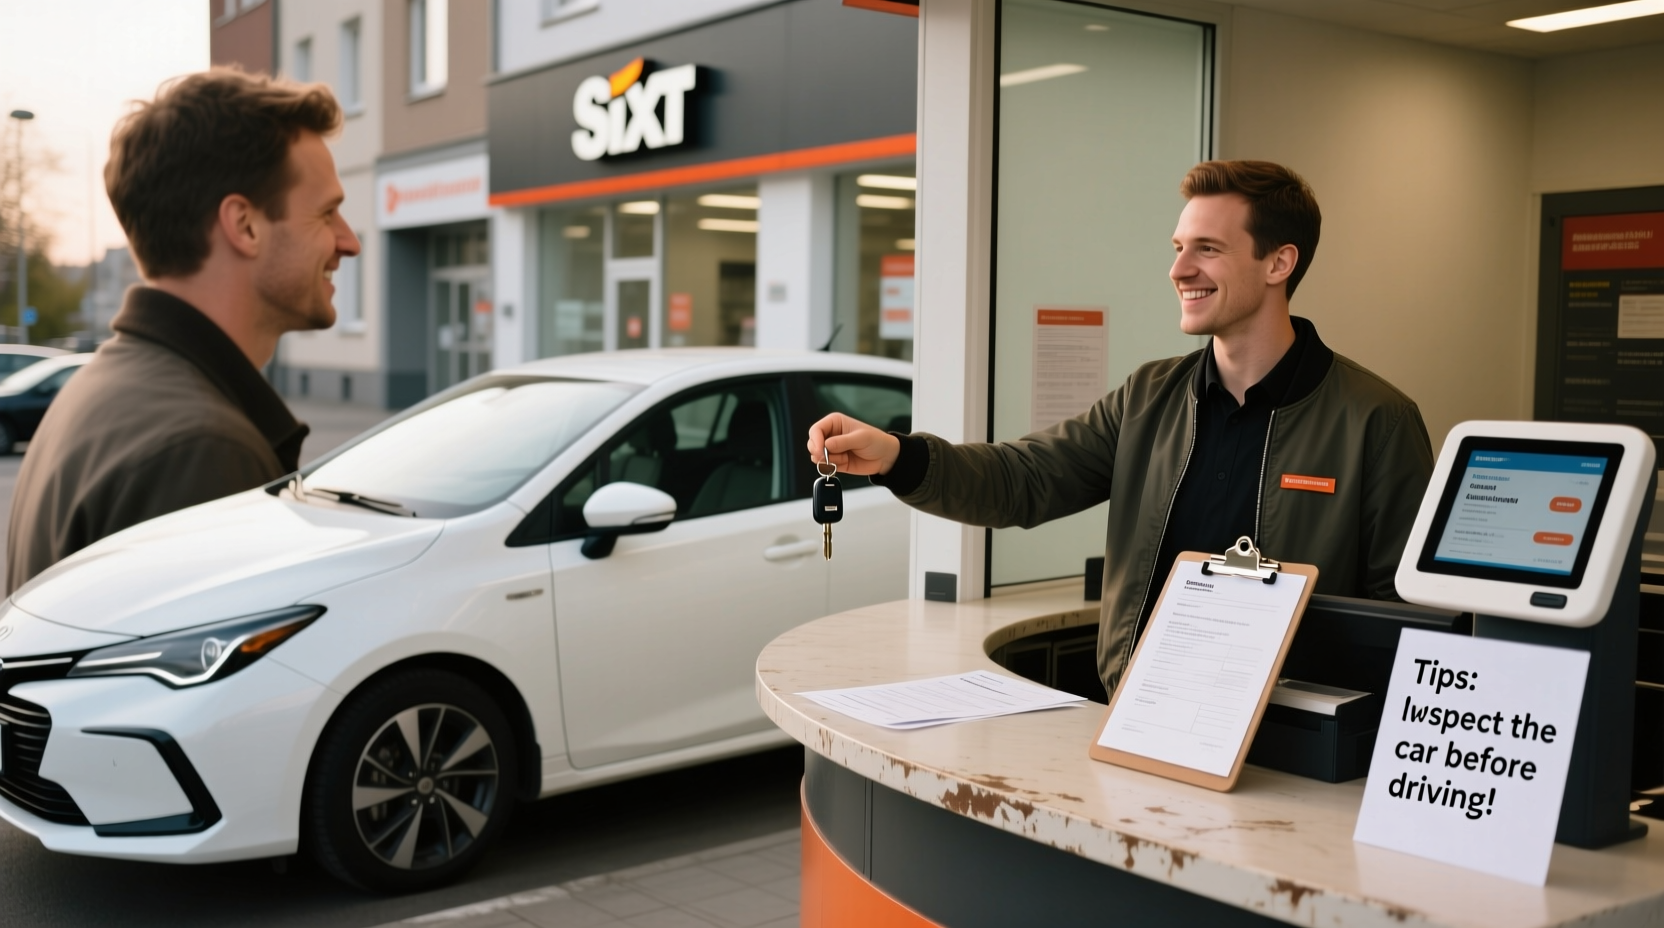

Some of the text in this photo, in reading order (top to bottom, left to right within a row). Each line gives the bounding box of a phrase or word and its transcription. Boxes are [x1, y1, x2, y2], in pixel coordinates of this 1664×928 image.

[1414, 658, 1478, 695] Tips:
[1510, 712, 1557, 744] the
[1394, 740, 1537, 781] car before
[1388, 772, 1497, 820] driving!
